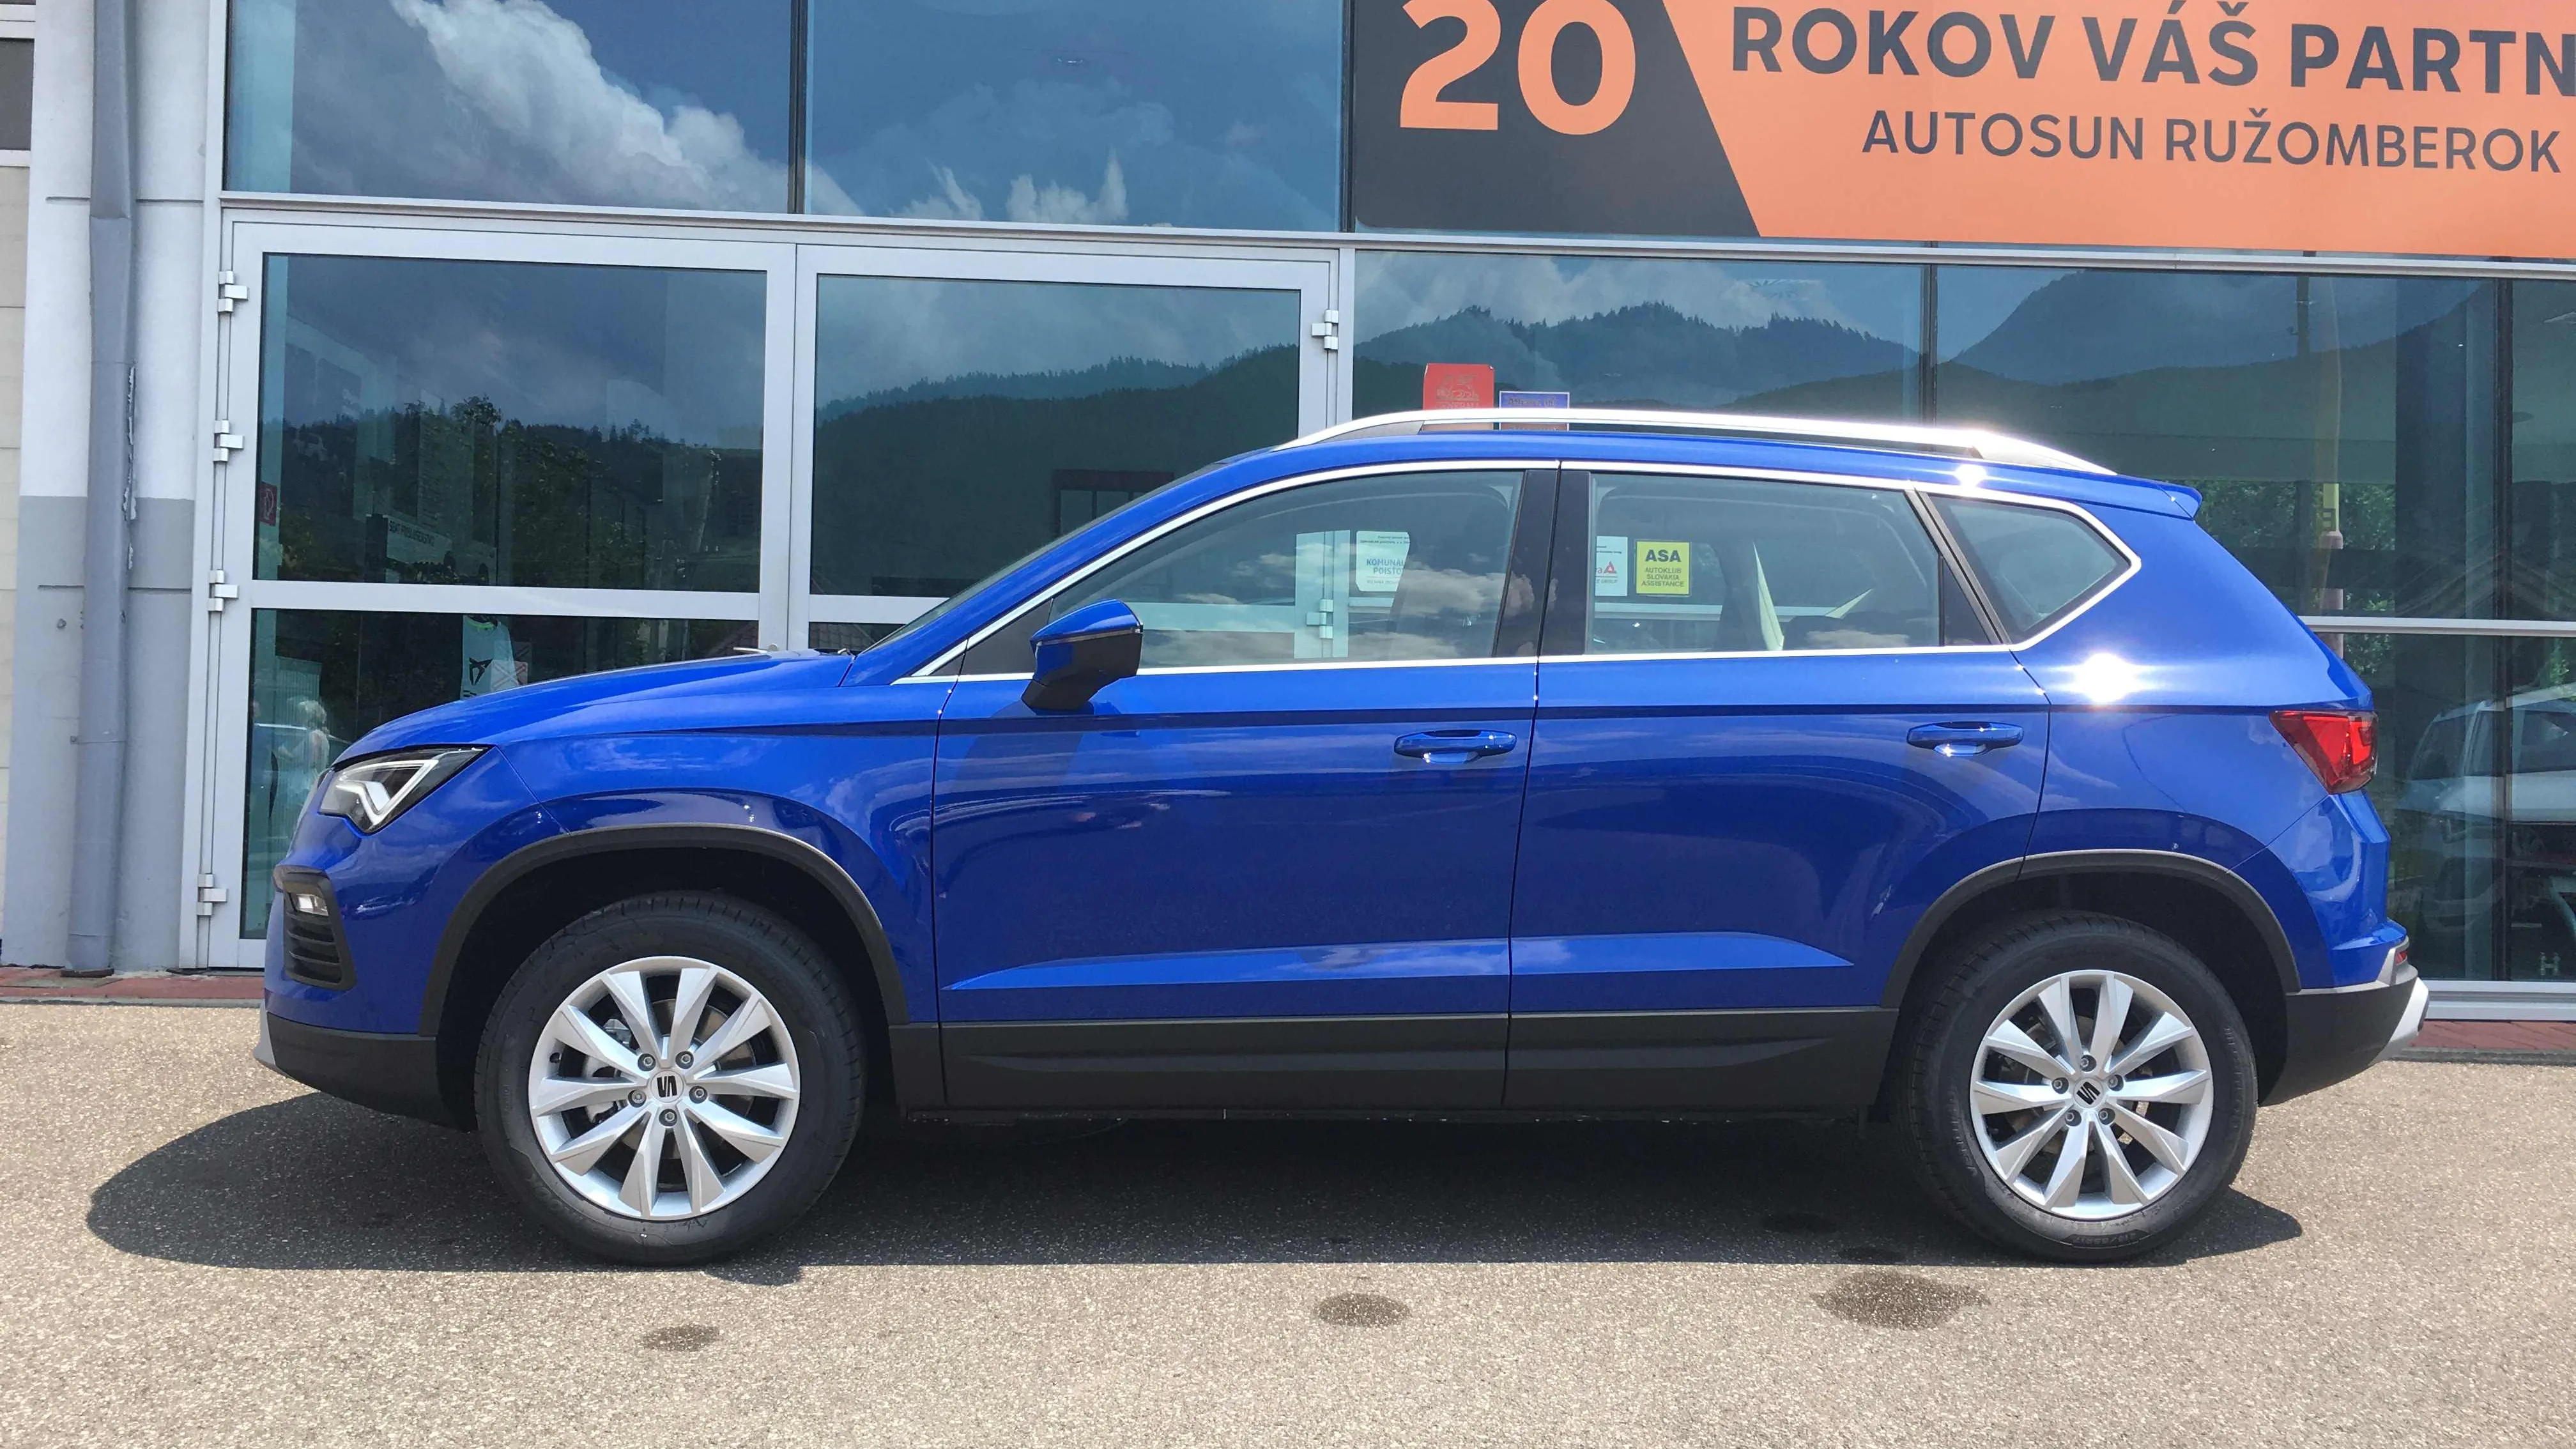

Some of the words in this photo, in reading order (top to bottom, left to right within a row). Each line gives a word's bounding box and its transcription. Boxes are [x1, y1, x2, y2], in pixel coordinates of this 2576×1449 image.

[1401, 0, 1636, 135] 20
[1731, 5, 2055, 80] ROKOV
[2081, 0, 2259, 88] VÁŠ
[2289, 22, 2576, 98] PARTN
[1862, 109, 2145, 162] AUTOSUN
[2165, 107, 2561, 173] RUŽOMBEROK
[1644, 549, 1682, 562] ASA
